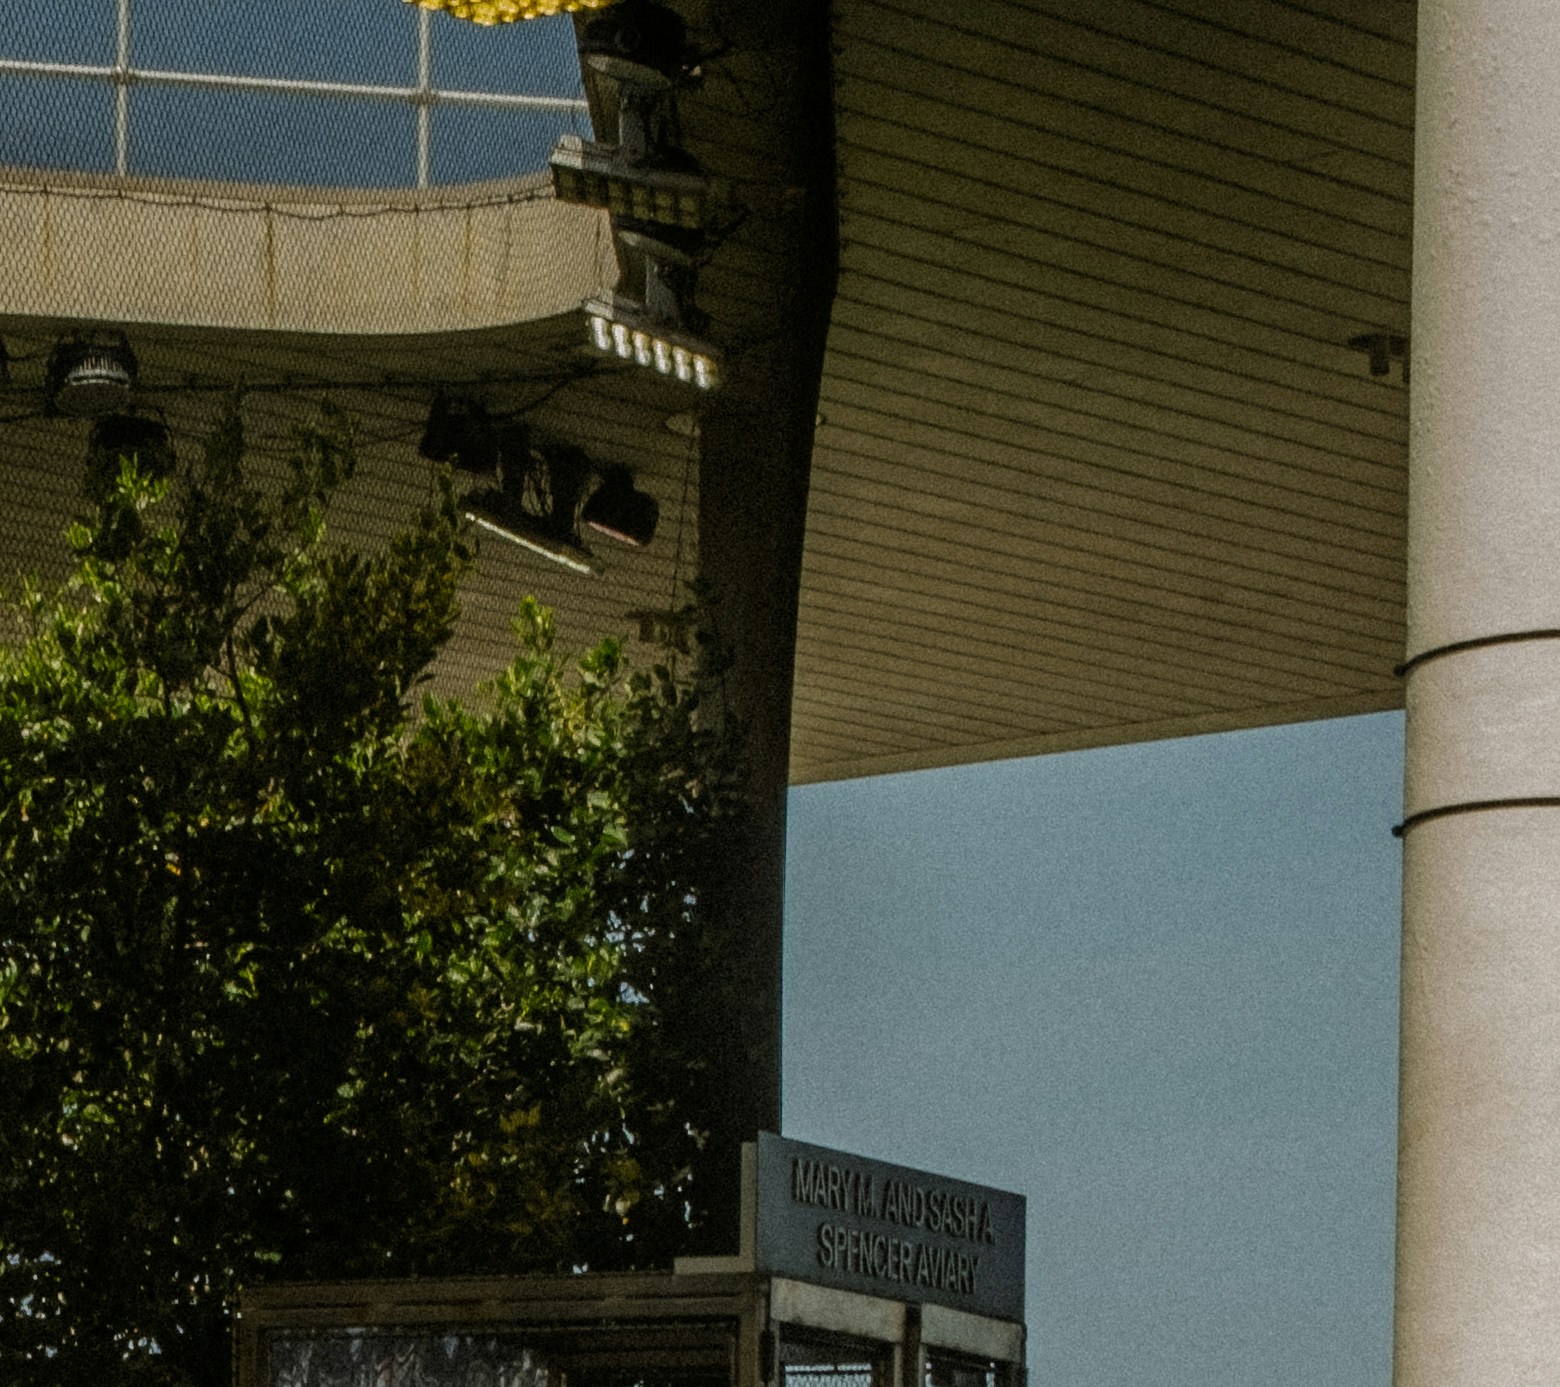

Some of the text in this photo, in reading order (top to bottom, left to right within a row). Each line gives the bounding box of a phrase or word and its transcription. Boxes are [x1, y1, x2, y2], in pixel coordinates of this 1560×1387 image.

[792, 1158, 853, 1211] MARY
[855, 1171, 881, 1217] M.
[883, 1180, 926, 1227] AND
[915, 1242, 981, 1295] AVIARY
